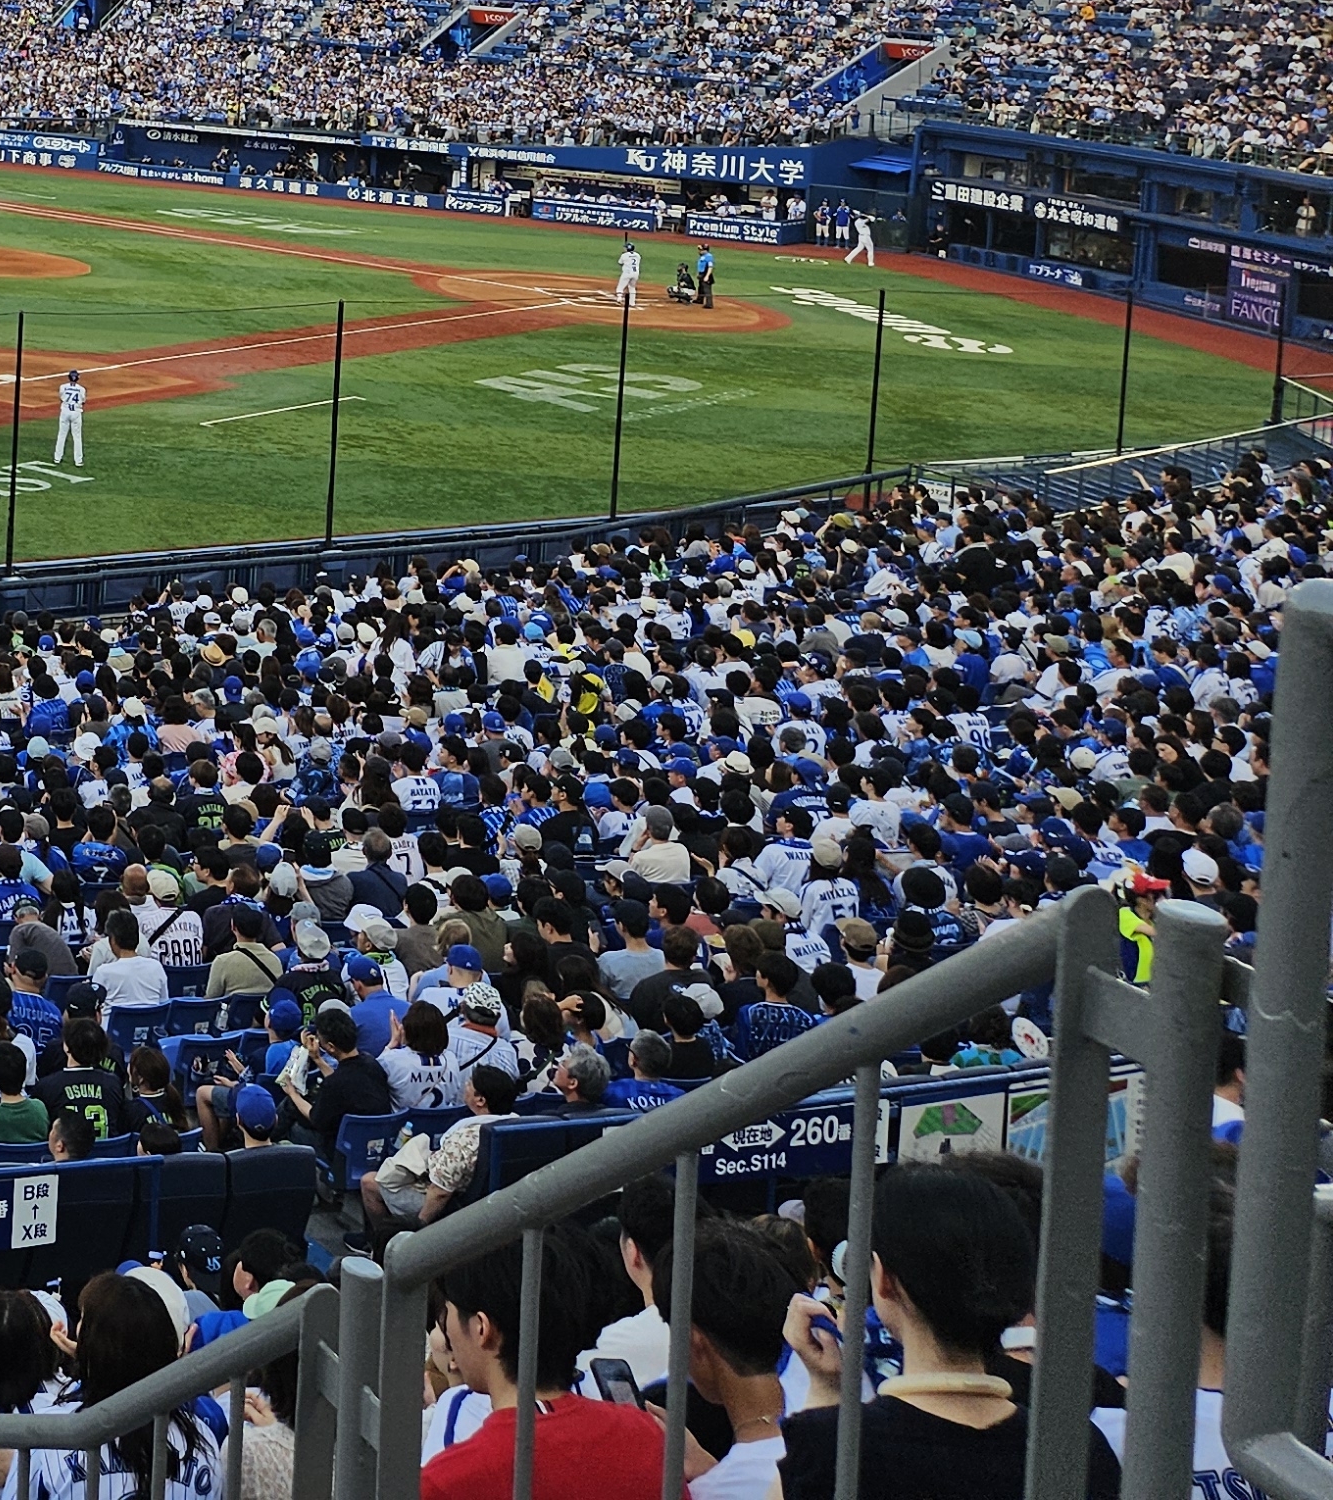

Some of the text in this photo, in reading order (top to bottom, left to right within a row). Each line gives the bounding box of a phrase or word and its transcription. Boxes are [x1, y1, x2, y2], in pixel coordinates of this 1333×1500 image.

[662, 149, 805, 185] 神奈川大学
[240, 177, 318, 196] 津久見建設
[362, 190, 428, 207] 北浦工業
[555, 212, 649, 230] リアルホールディングス
[1047, 206, 1118, 231] 丸全昭和運輸
[689, 220, 739, 235] Premium
[743, 225, 777, 239] Style
[66, 392, 78, 403] 74
[398, 852, 410, 875] 7
[159, 939, 202, 965] 2896
[411, 1071, 452, 1085] MAKI
[65, 1084, 102, 1101] OSUNA
[733, 1126, 772, 1146] 現在地
[715, 1152, 786, 1176] Sec.S114
[22, 1181, 50, 1201] B段
[22, 1221, 47, 1241] X段
